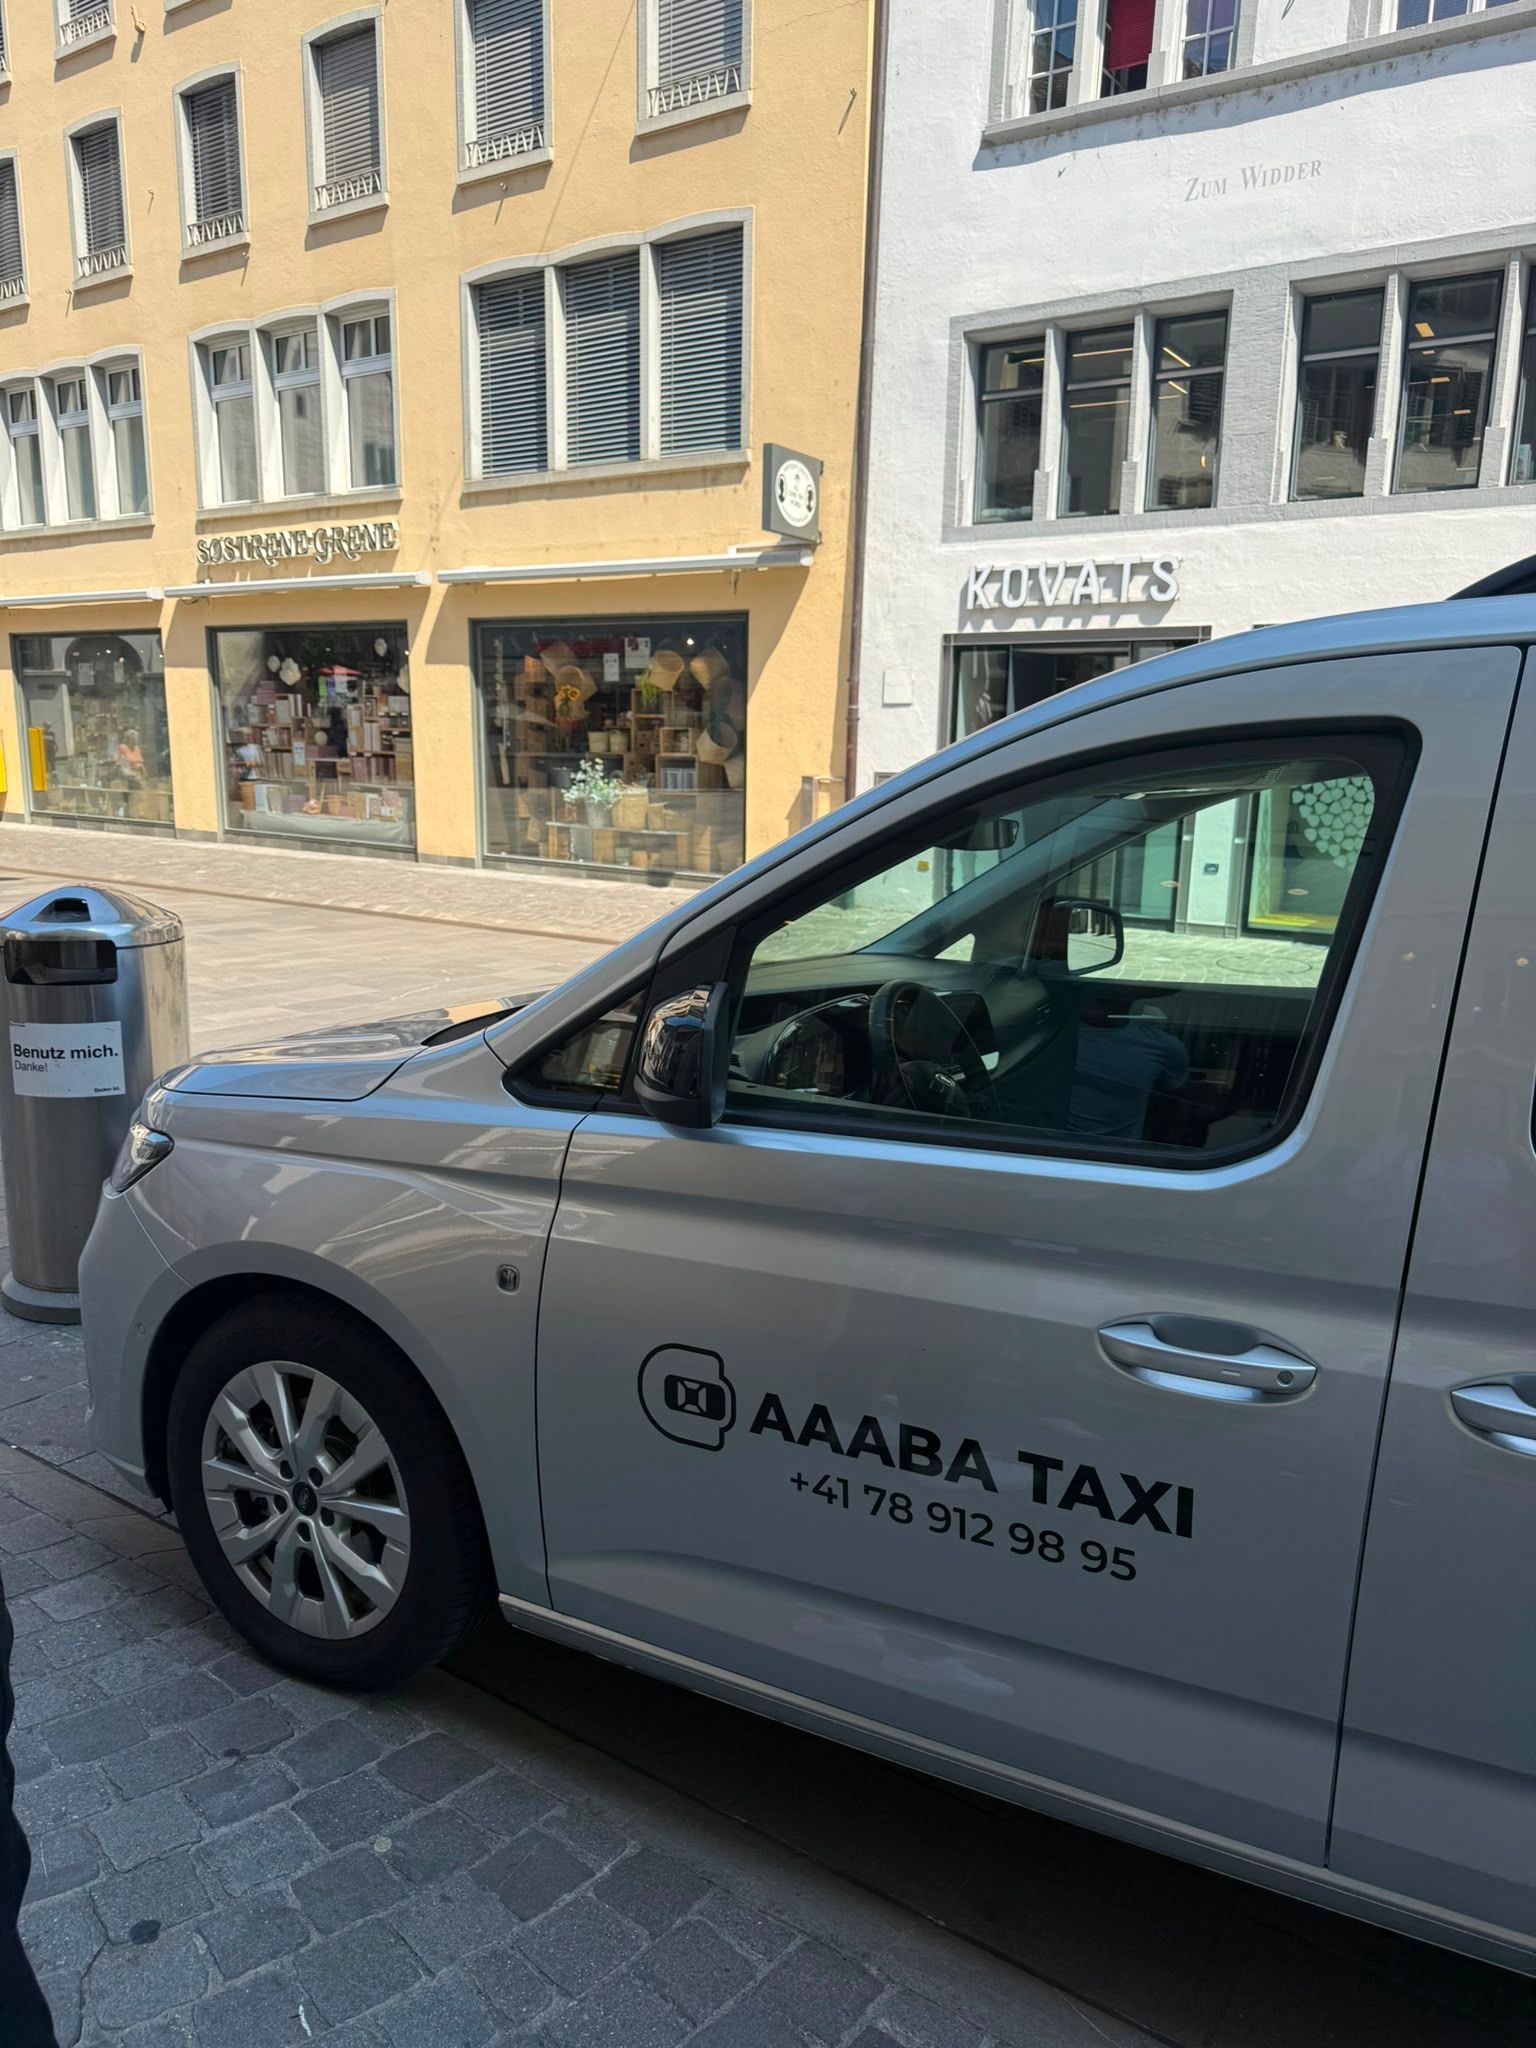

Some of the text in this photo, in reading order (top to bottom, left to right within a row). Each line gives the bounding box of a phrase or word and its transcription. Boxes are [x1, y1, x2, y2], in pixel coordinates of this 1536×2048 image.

[313, 522, 395, 563] GRENE
[966, 555, 1179, 609] KOVATS
[13, 1043, 119, 1060] Benutz mich.
[14, 1060, 48, 1073] Danke!
[749, 1391, 1195, 1539] AAABA TAXI
[790, 1471, 1137, 1582] +41 78 912 98 95
